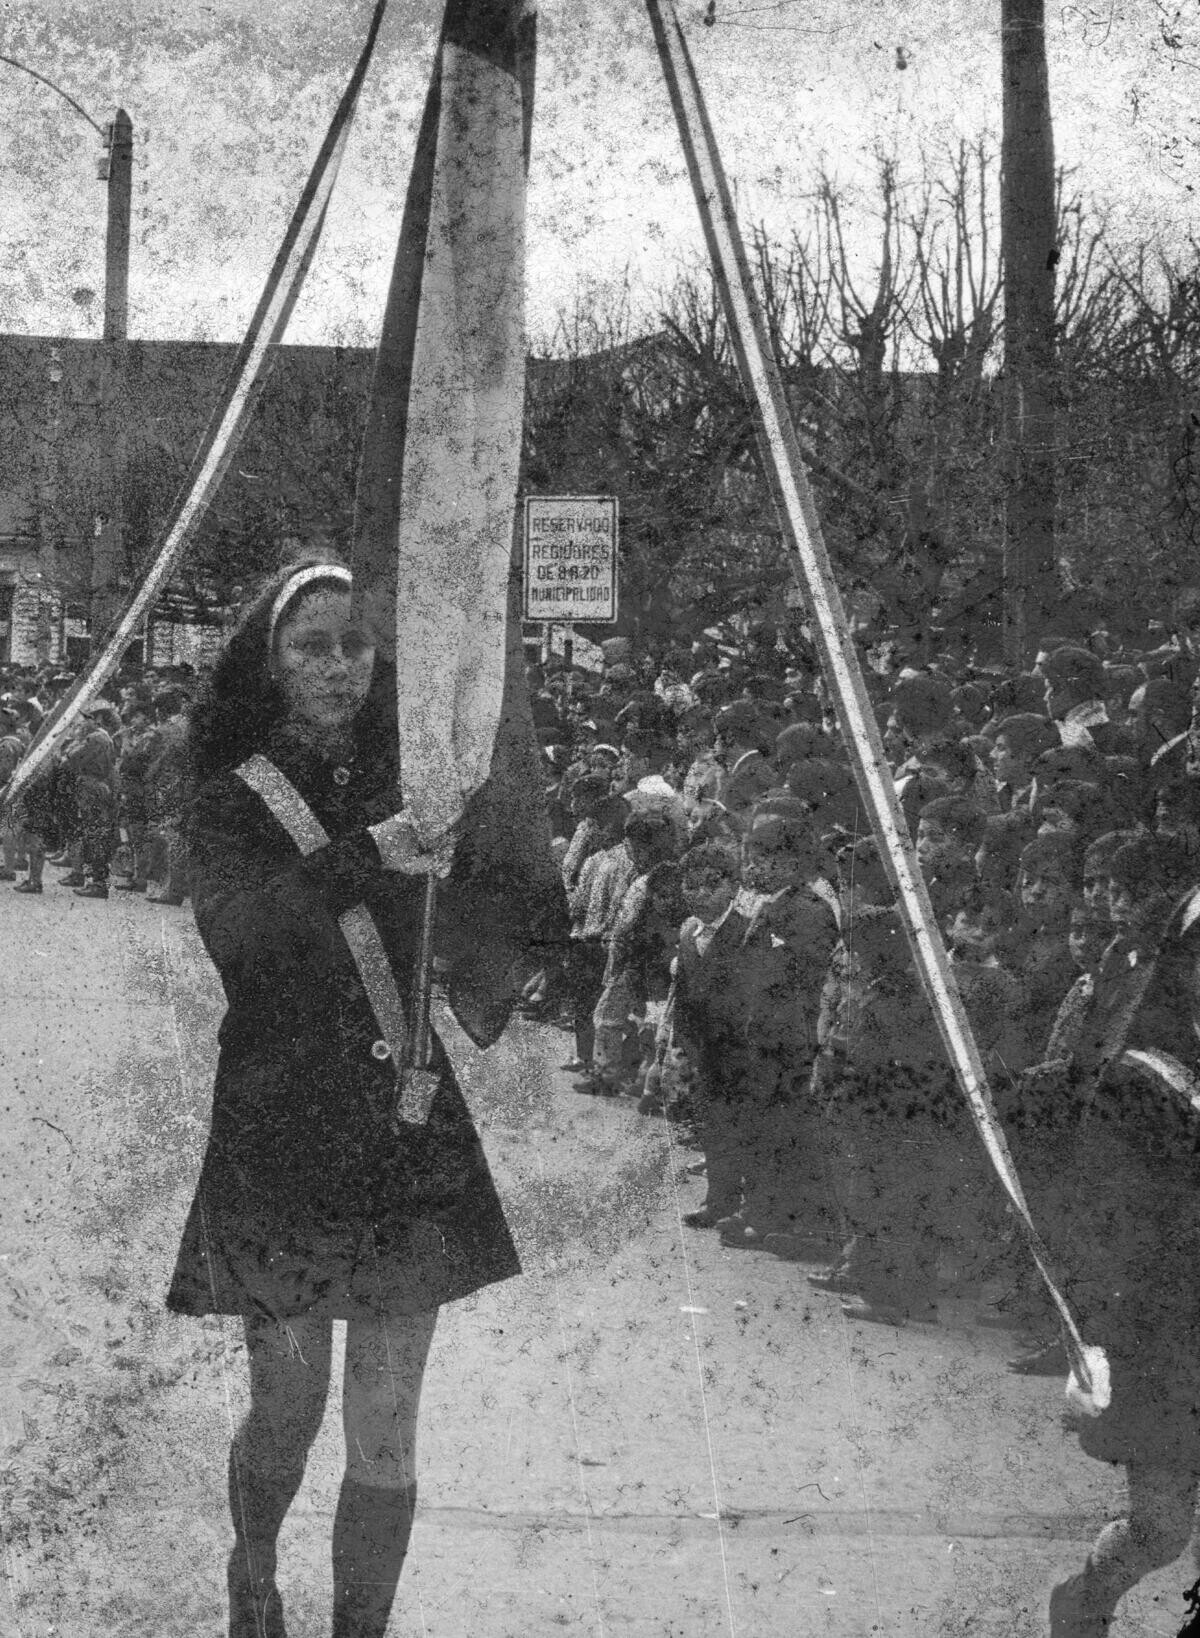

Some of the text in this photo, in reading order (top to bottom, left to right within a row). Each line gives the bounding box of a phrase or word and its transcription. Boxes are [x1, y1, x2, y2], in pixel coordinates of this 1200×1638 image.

[532, 518, 610, 533] RESERVADO
[532, 545, 610, 560] REGIDORES
[537, 566, 554, 580] DE
[531, 587, 610, 601] MUNICIPALIDAD
